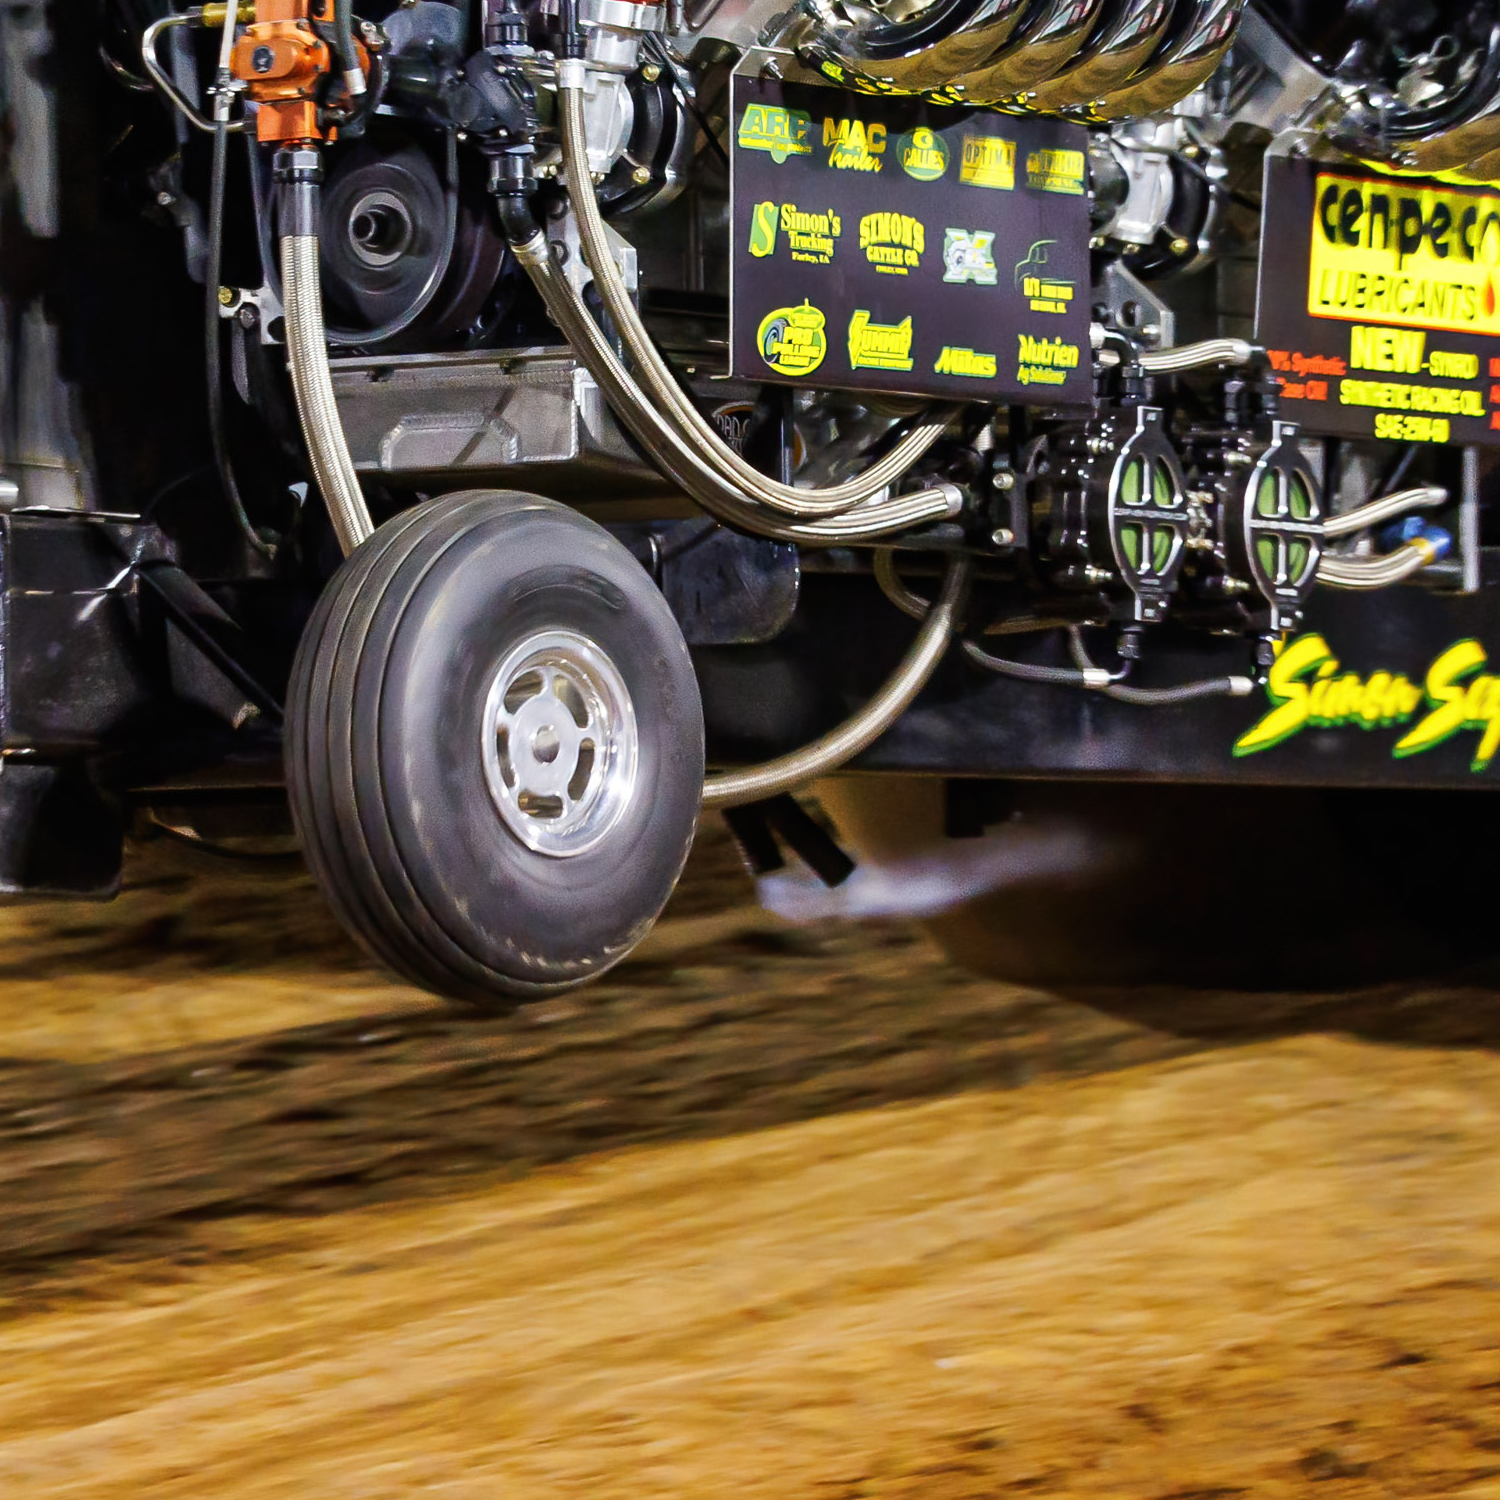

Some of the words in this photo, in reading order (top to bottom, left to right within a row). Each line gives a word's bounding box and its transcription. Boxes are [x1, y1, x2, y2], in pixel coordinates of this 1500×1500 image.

[742, 109, 808, 140] ARP
[822, 116, 887, 154] MAC
[828, 139, 883, 173] Trailer
[903, 148, 945, 171] CALLIES
[964, 143, 1016, 168] OPTIMA
[780, 204, 842, 237] Simon's
[860, 212, 925, 255] SIMON'S
[788, 231, 835, 257] Trucking
[866, 246, 904, 265] CATTLE
[1318, 268, 1477, 321] LUBRICANTS
[848, 310, 913, 370] SUMMIT
[1017, 333, 1080, 368] Nutrien
[1349, 324, 1427, 375] NEW
